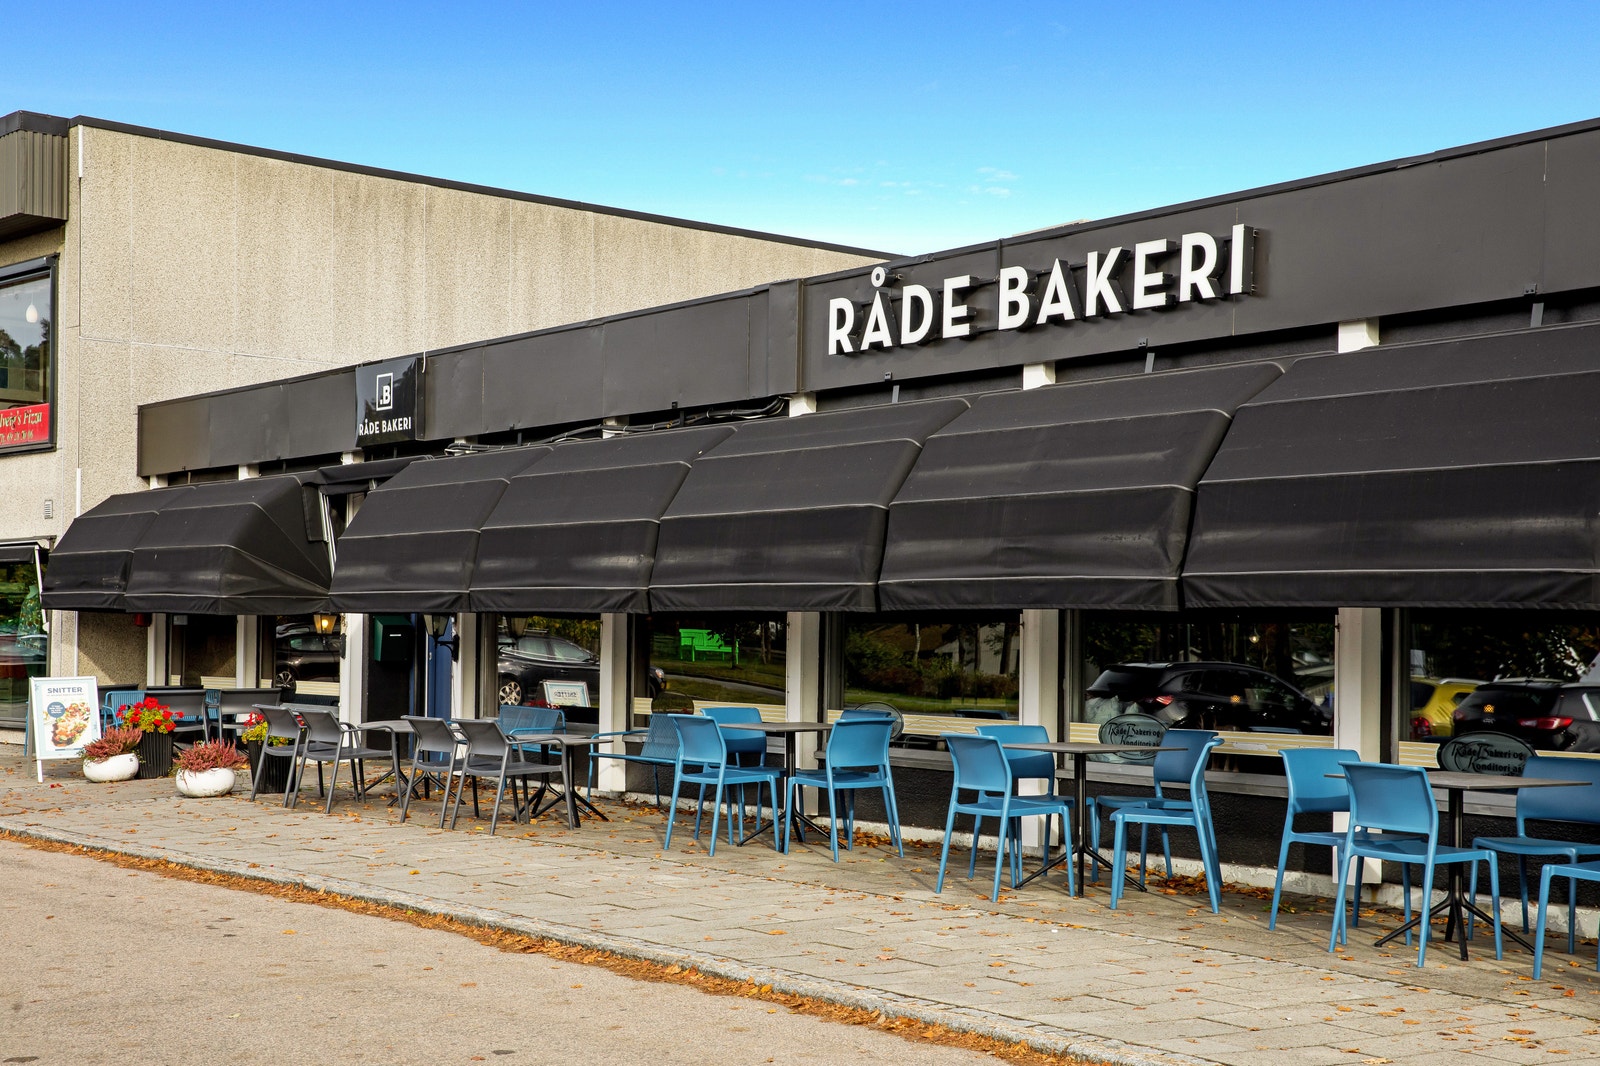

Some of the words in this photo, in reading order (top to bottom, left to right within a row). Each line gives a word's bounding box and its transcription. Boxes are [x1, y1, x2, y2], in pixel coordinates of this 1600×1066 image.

[829, 266, 972, 355] RÅDE
[998, 224, 1245, 331] BAKERI
[23, 409, 42, 425] Pizza
[359, 419, 380, 436] RÅDE
[381, 416, 412, 433] BAKERI
[47, 686, 83, 694] SNITTER
[1125, 723, 1151, 738] Bakeri
[1152, 730, 1161, 738] og
[1476, 743, 1511, 760] Bakeri
[1512, 752, 1524, 761] og
[1467, 756, 1511, 773] Konditori
